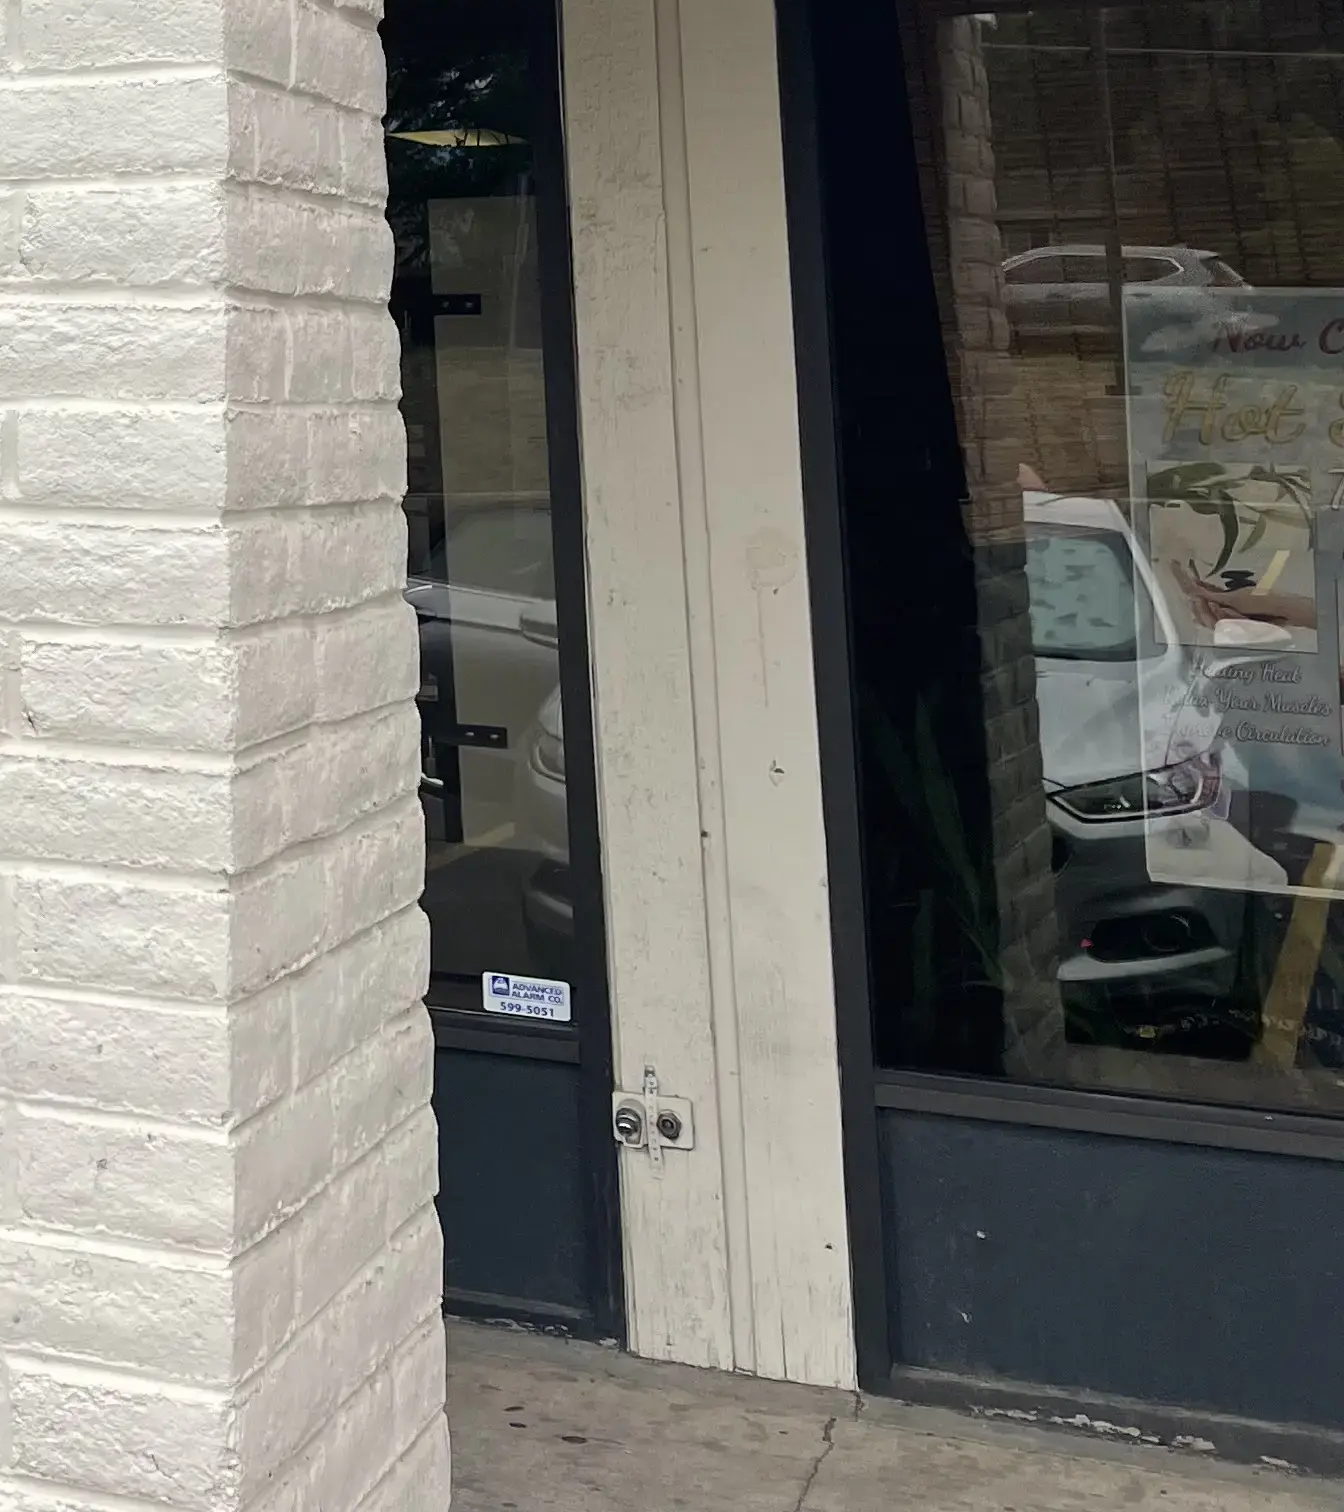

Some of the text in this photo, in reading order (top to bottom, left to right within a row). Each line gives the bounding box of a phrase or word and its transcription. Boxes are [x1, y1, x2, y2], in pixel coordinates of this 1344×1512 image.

[1164, 371, 1306, 445] Hot
[512, 983, 562, 996] ADVANCED
[512, 991, 545, 1002] ALARM
[500, 1001, 554, 1017] 599-5051
